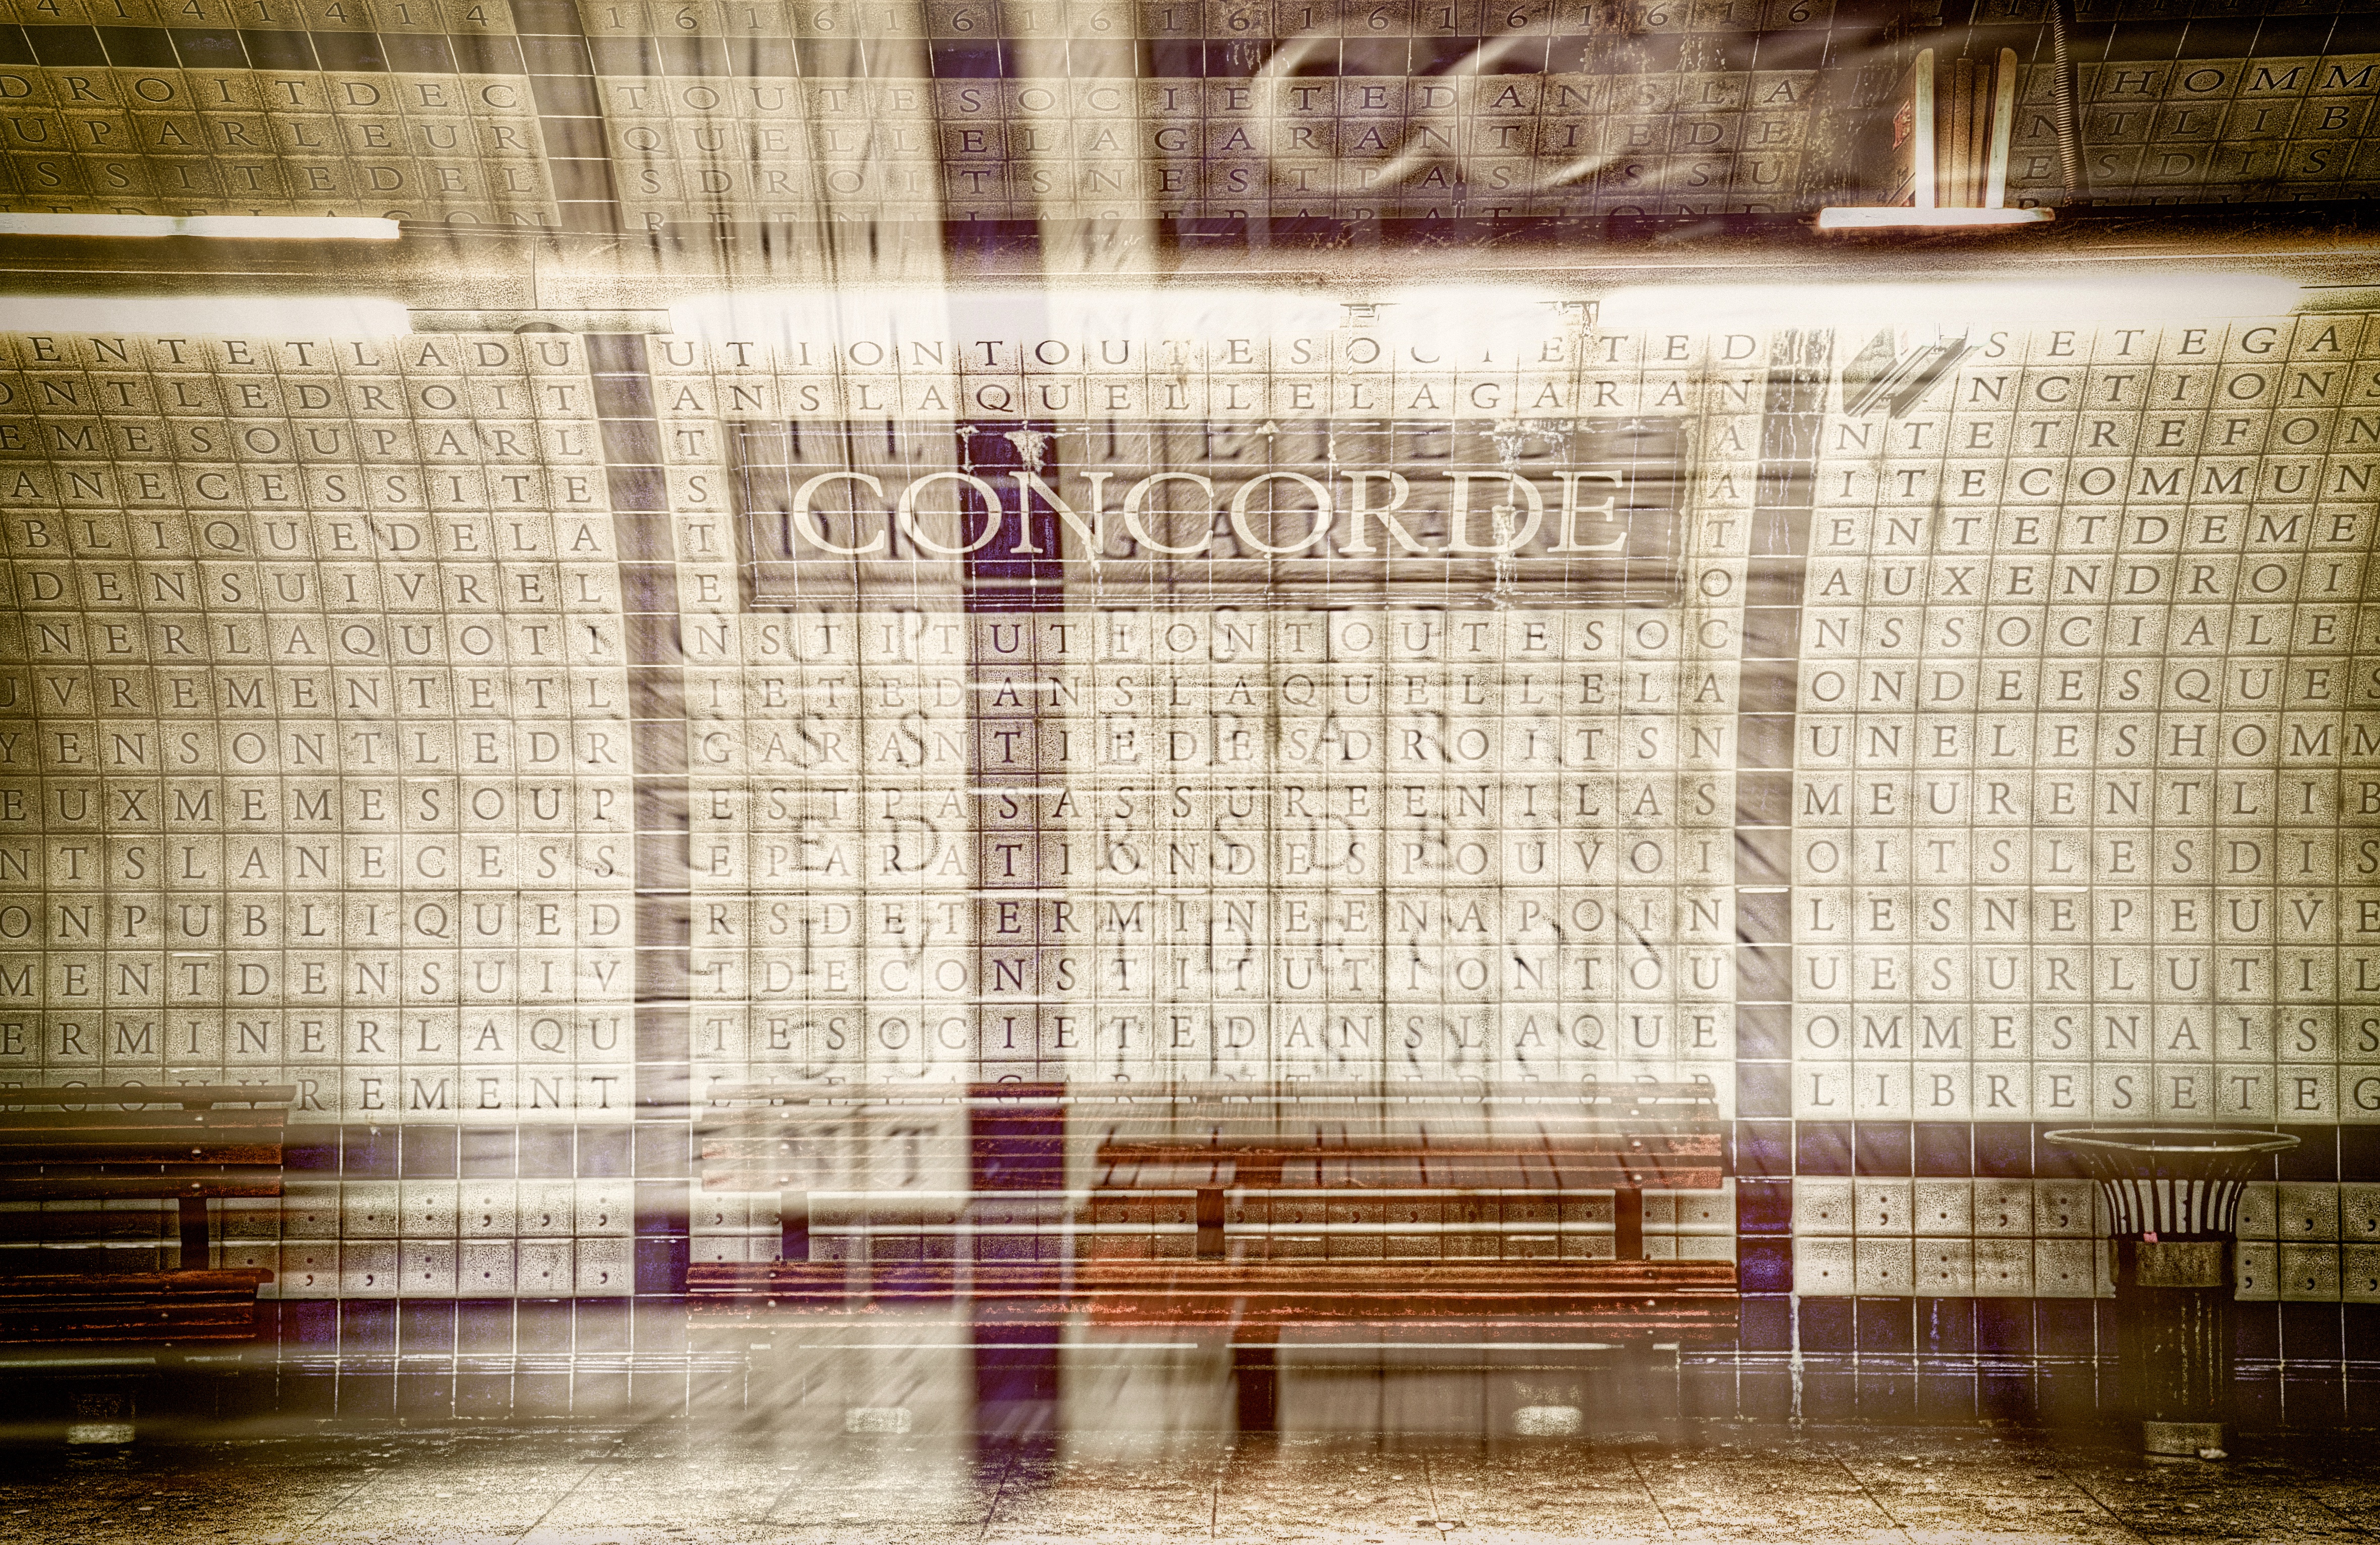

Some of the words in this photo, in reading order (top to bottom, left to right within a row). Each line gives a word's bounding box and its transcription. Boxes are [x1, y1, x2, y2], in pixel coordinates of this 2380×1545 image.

[0, 337, 571, 367] ENTETLADU
[791, 470, 1628, 557] CONCORDE
[1815, 615, 2380, 649] NSSOCIALE
